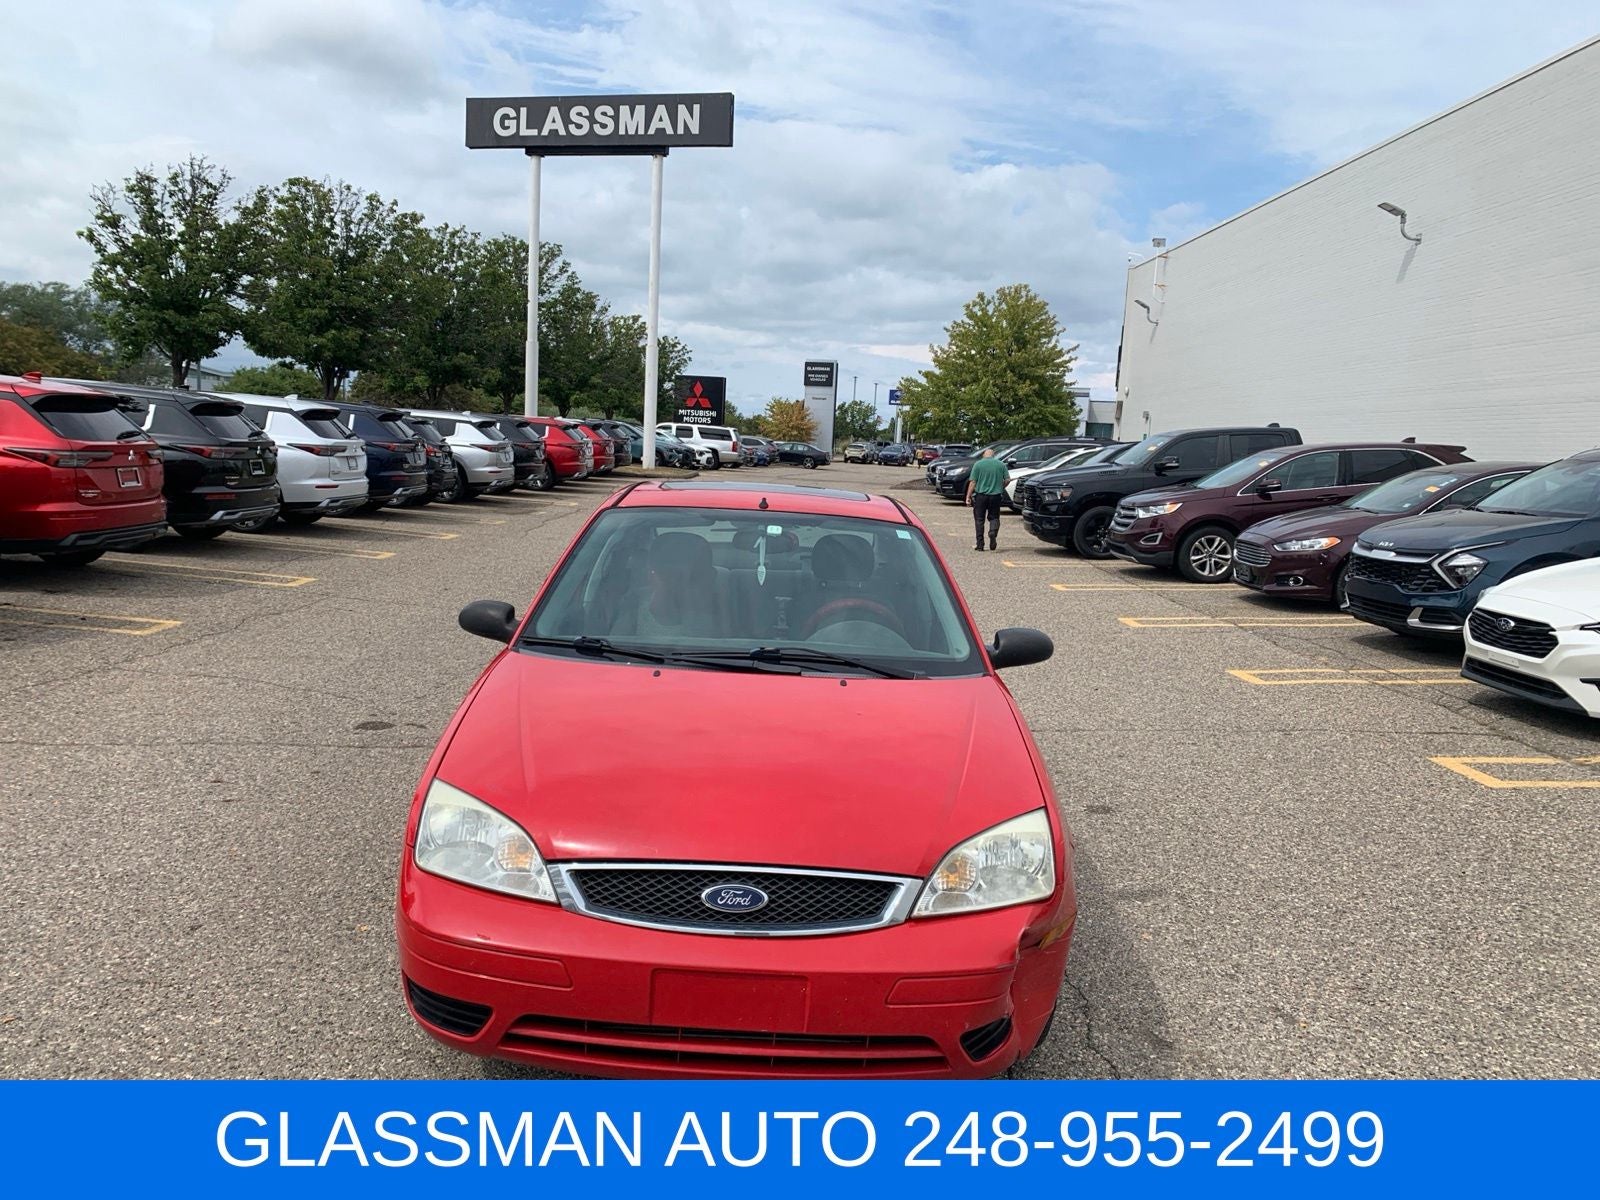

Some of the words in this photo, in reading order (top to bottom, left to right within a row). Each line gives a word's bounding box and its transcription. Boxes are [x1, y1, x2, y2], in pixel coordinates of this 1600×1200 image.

[493, 103, 700, 136] GLASSMAN
[679, 409, 717, 417] MITSUBISHI
[683, 416, 711, 424] MOTORS
[717, 889, 752, 906] Ford
